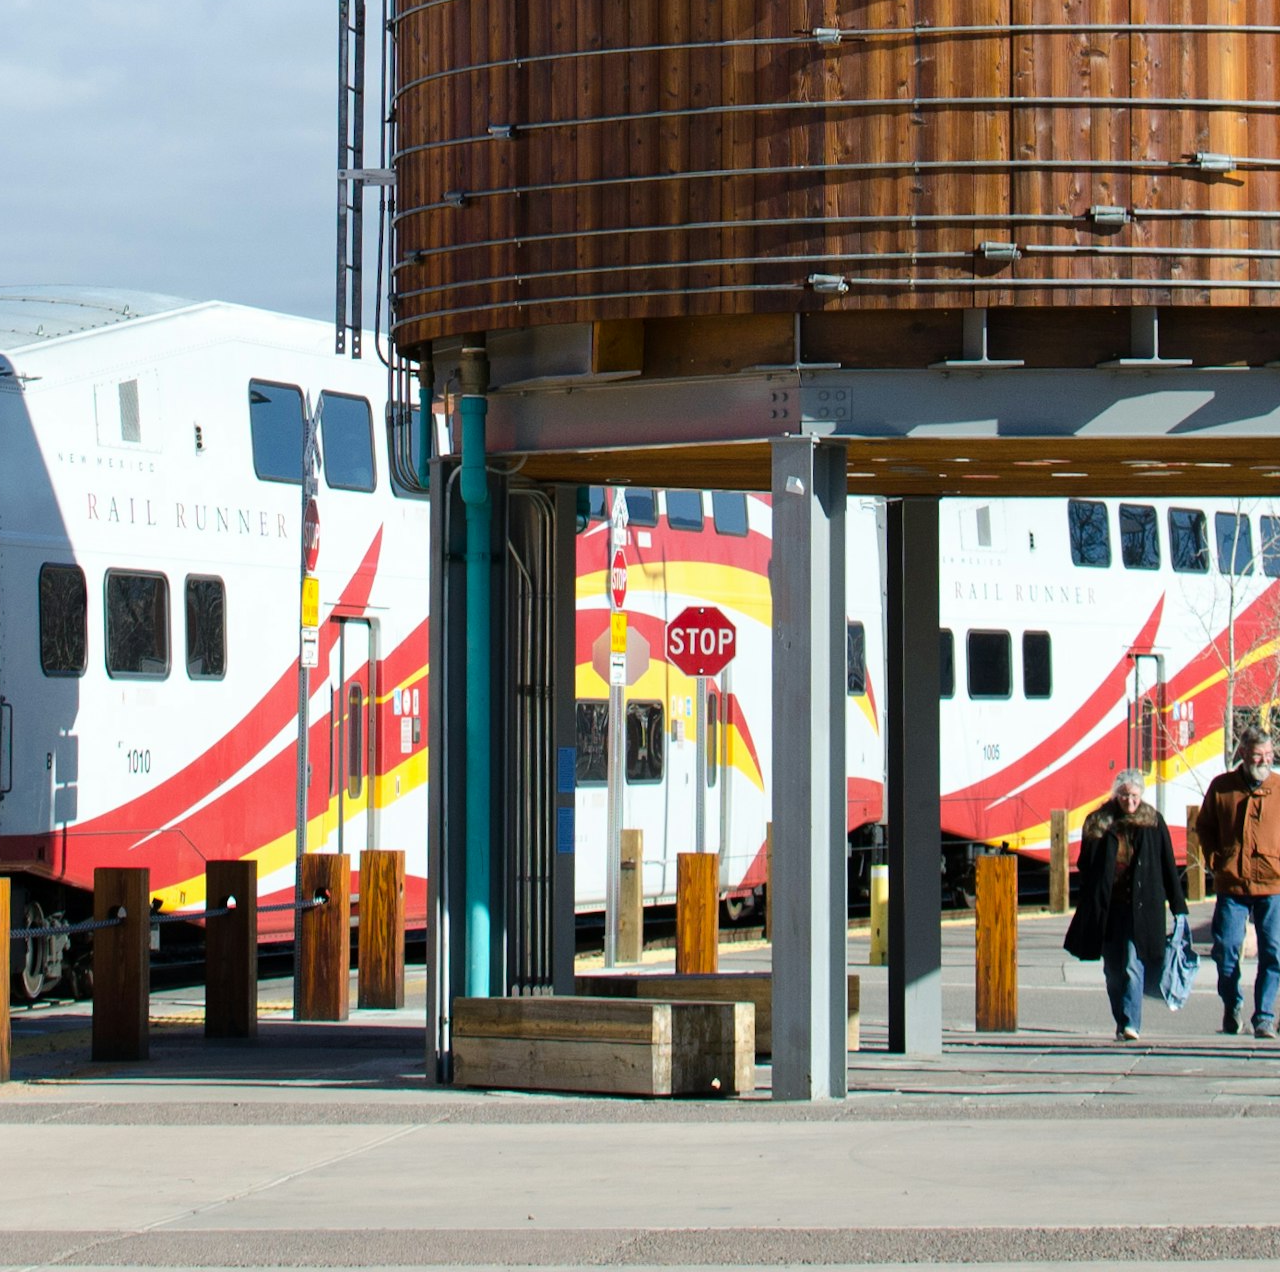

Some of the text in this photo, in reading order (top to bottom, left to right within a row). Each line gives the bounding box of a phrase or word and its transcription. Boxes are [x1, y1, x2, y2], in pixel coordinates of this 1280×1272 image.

[58, 452, 155, 473] NEW MEXICO
[87, 493, 288, 538] RAIL RUNNER
[304, 522, 320, 550] STOP
[612, 568, 626, 590] STOP
[955, 581, 1096, 605] RAIL RUNNER
[669, 627, 733, 655] STOP
[127, 749, 151, 774] 1010
